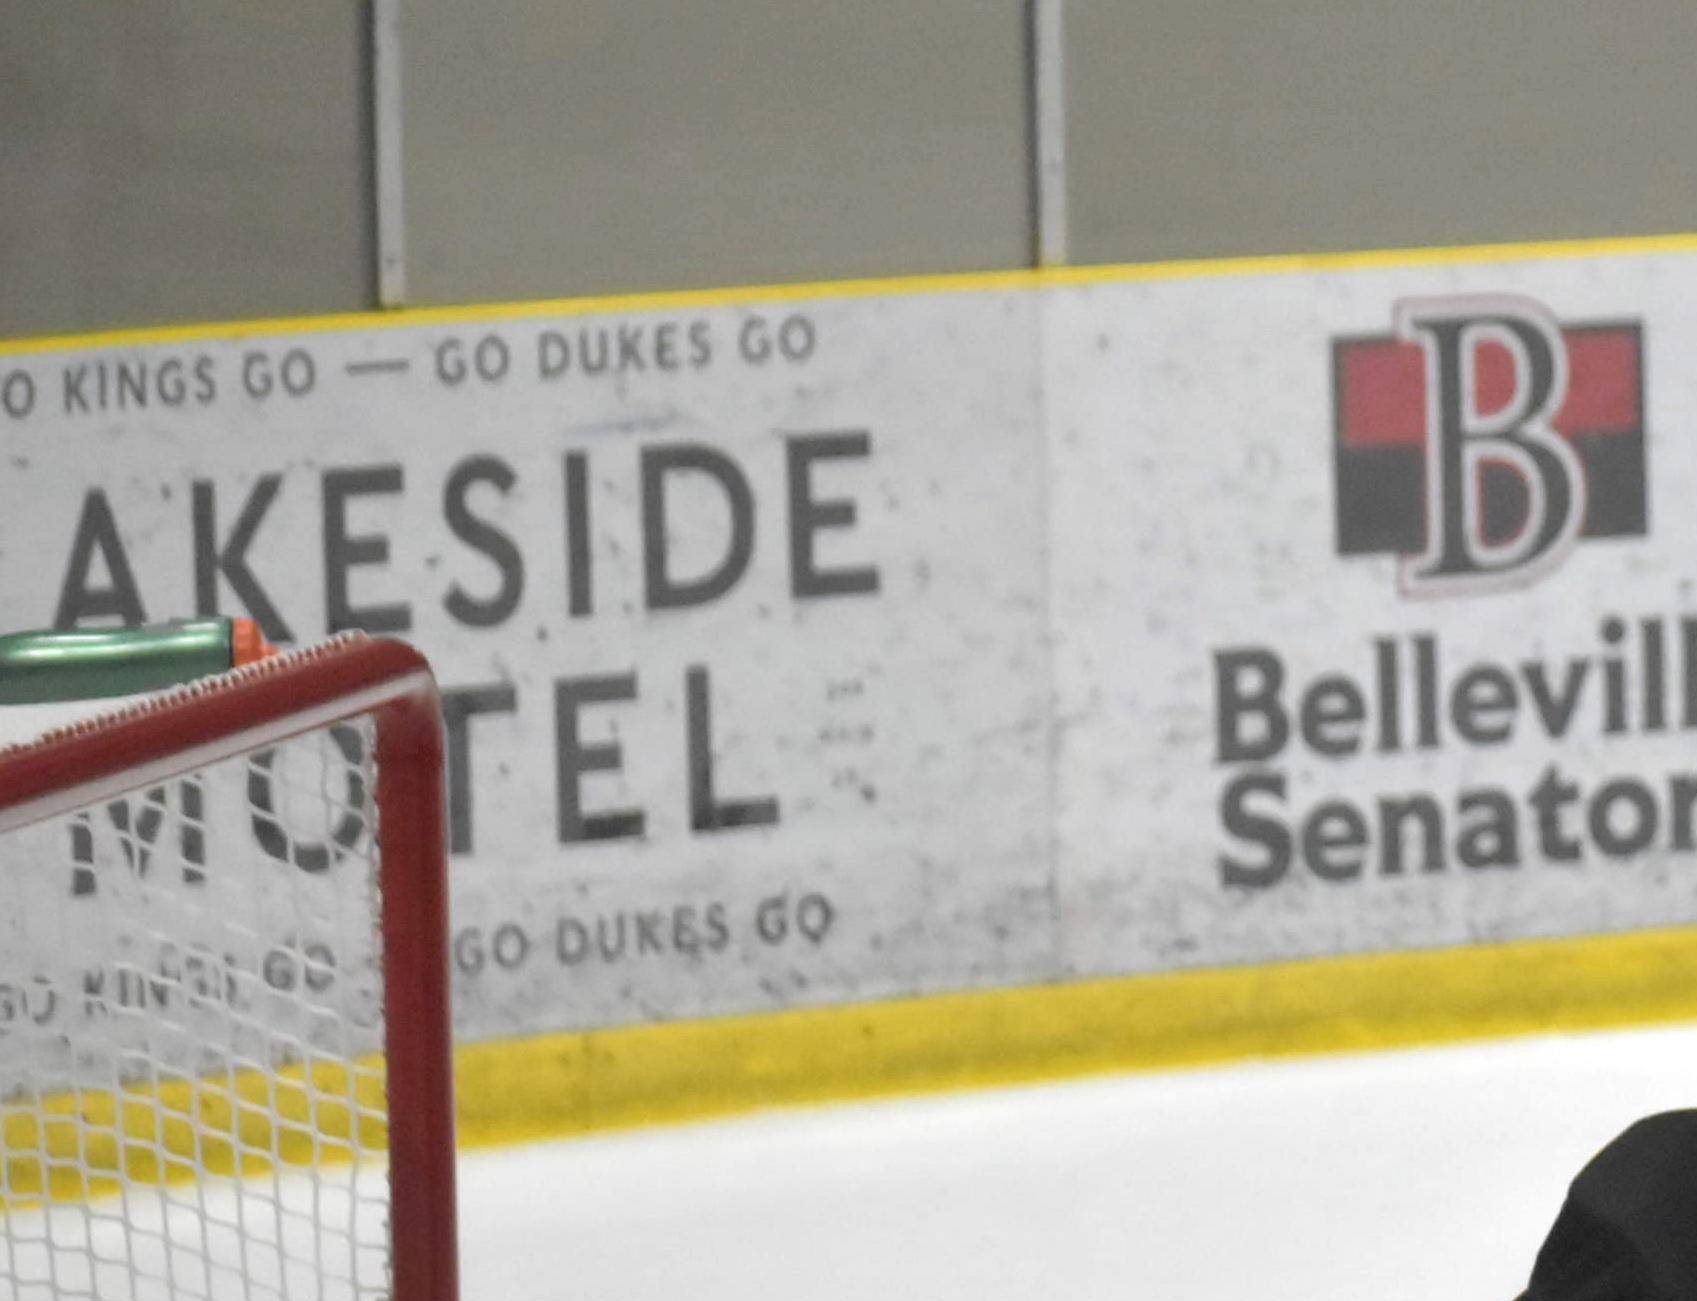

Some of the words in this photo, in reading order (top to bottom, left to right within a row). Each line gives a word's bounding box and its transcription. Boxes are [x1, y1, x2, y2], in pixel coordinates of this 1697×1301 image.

[62, 355, 217, 415] KINGS
[242, 348, 316, 401] GO
[434, 334, 510, 388] GO
[537, 319, 712, 381] DUKES
[738, 313, 817, 368] GO
[1395, 296, 1586, 596] B
[53, 430, 881, 643] AKESIDE
[70, 664, 780, 896] MOTEL
[454, 923, 531, 976] GO
[556, 902, 730, 966] DUKES
[755, 893, 836, 947] GO
